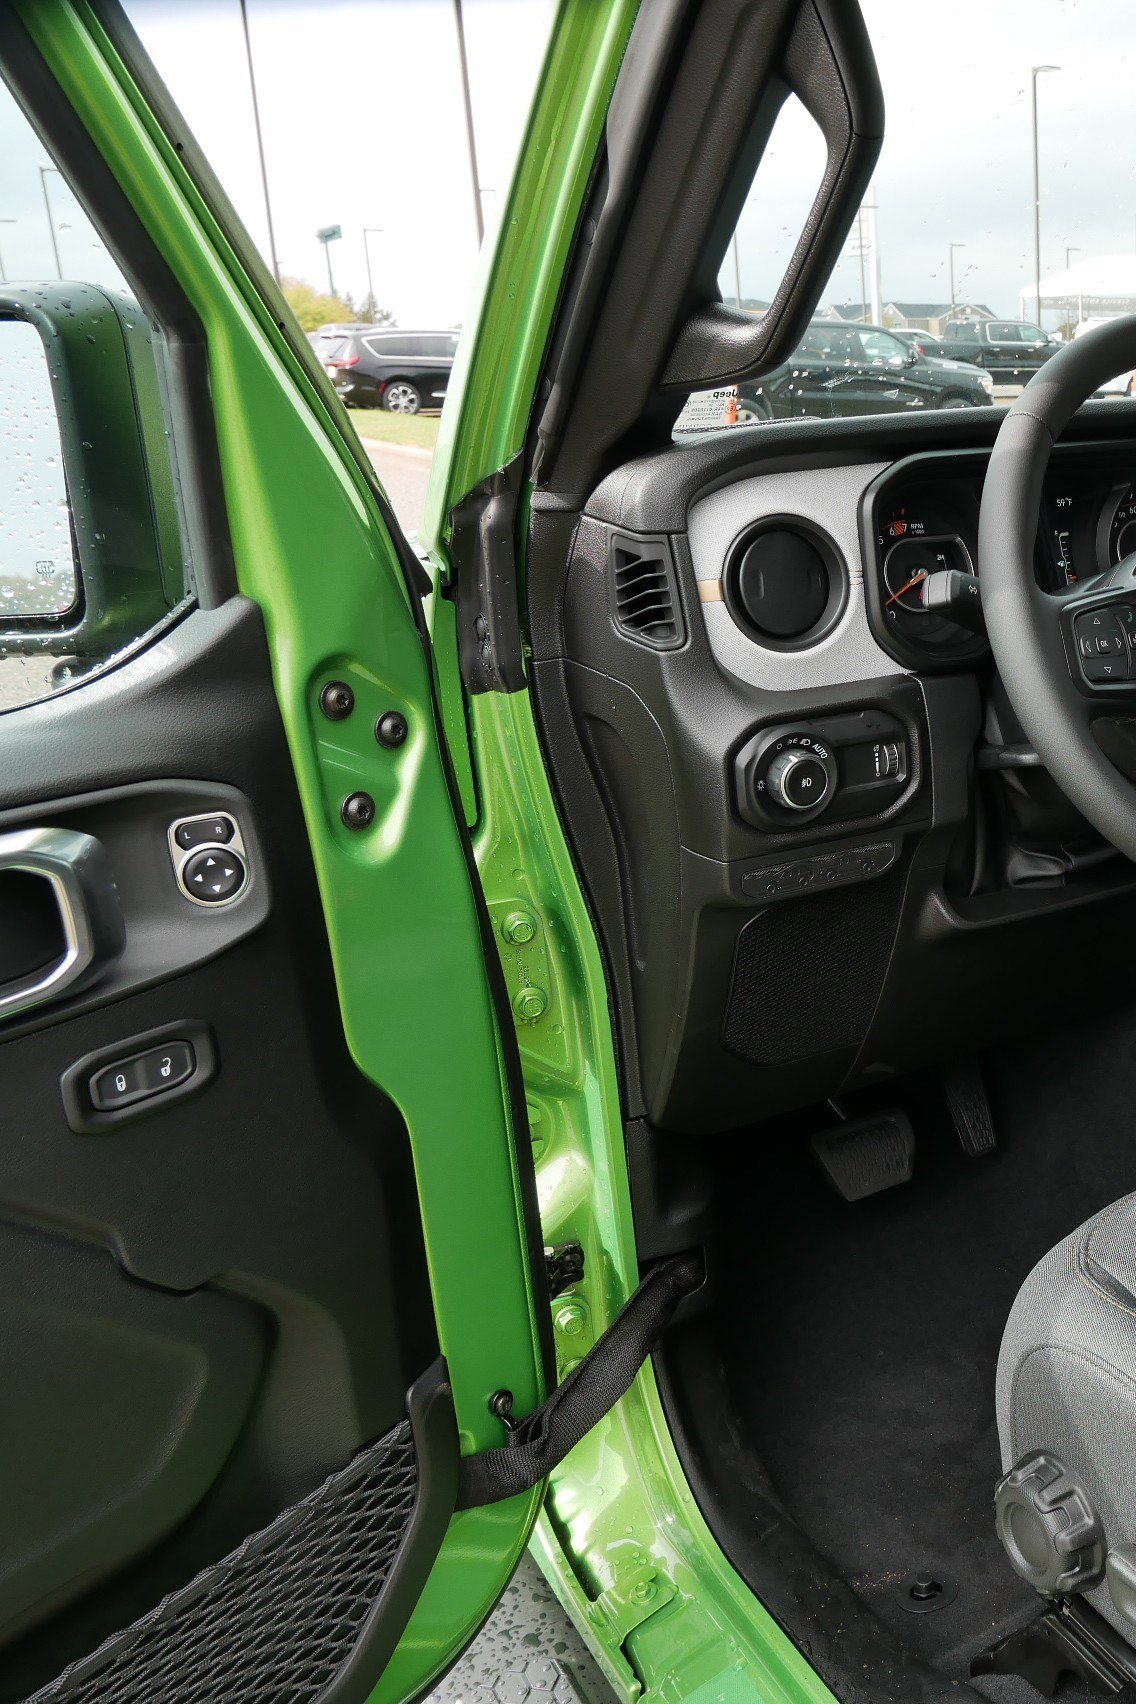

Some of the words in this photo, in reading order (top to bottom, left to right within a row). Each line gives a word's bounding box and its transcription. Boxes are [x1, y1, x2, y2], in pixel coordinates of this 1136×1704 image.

[902, 523, 908, 532] 7
[910, 522, 924, 530] RPM
[889, 526, 895, 536] 6
[1100, 640, 1108, 648] OK
[812, 743, 828, 759] AUTO
[184, 832, 191, 840] L
[215, 826, 222, 834] R
